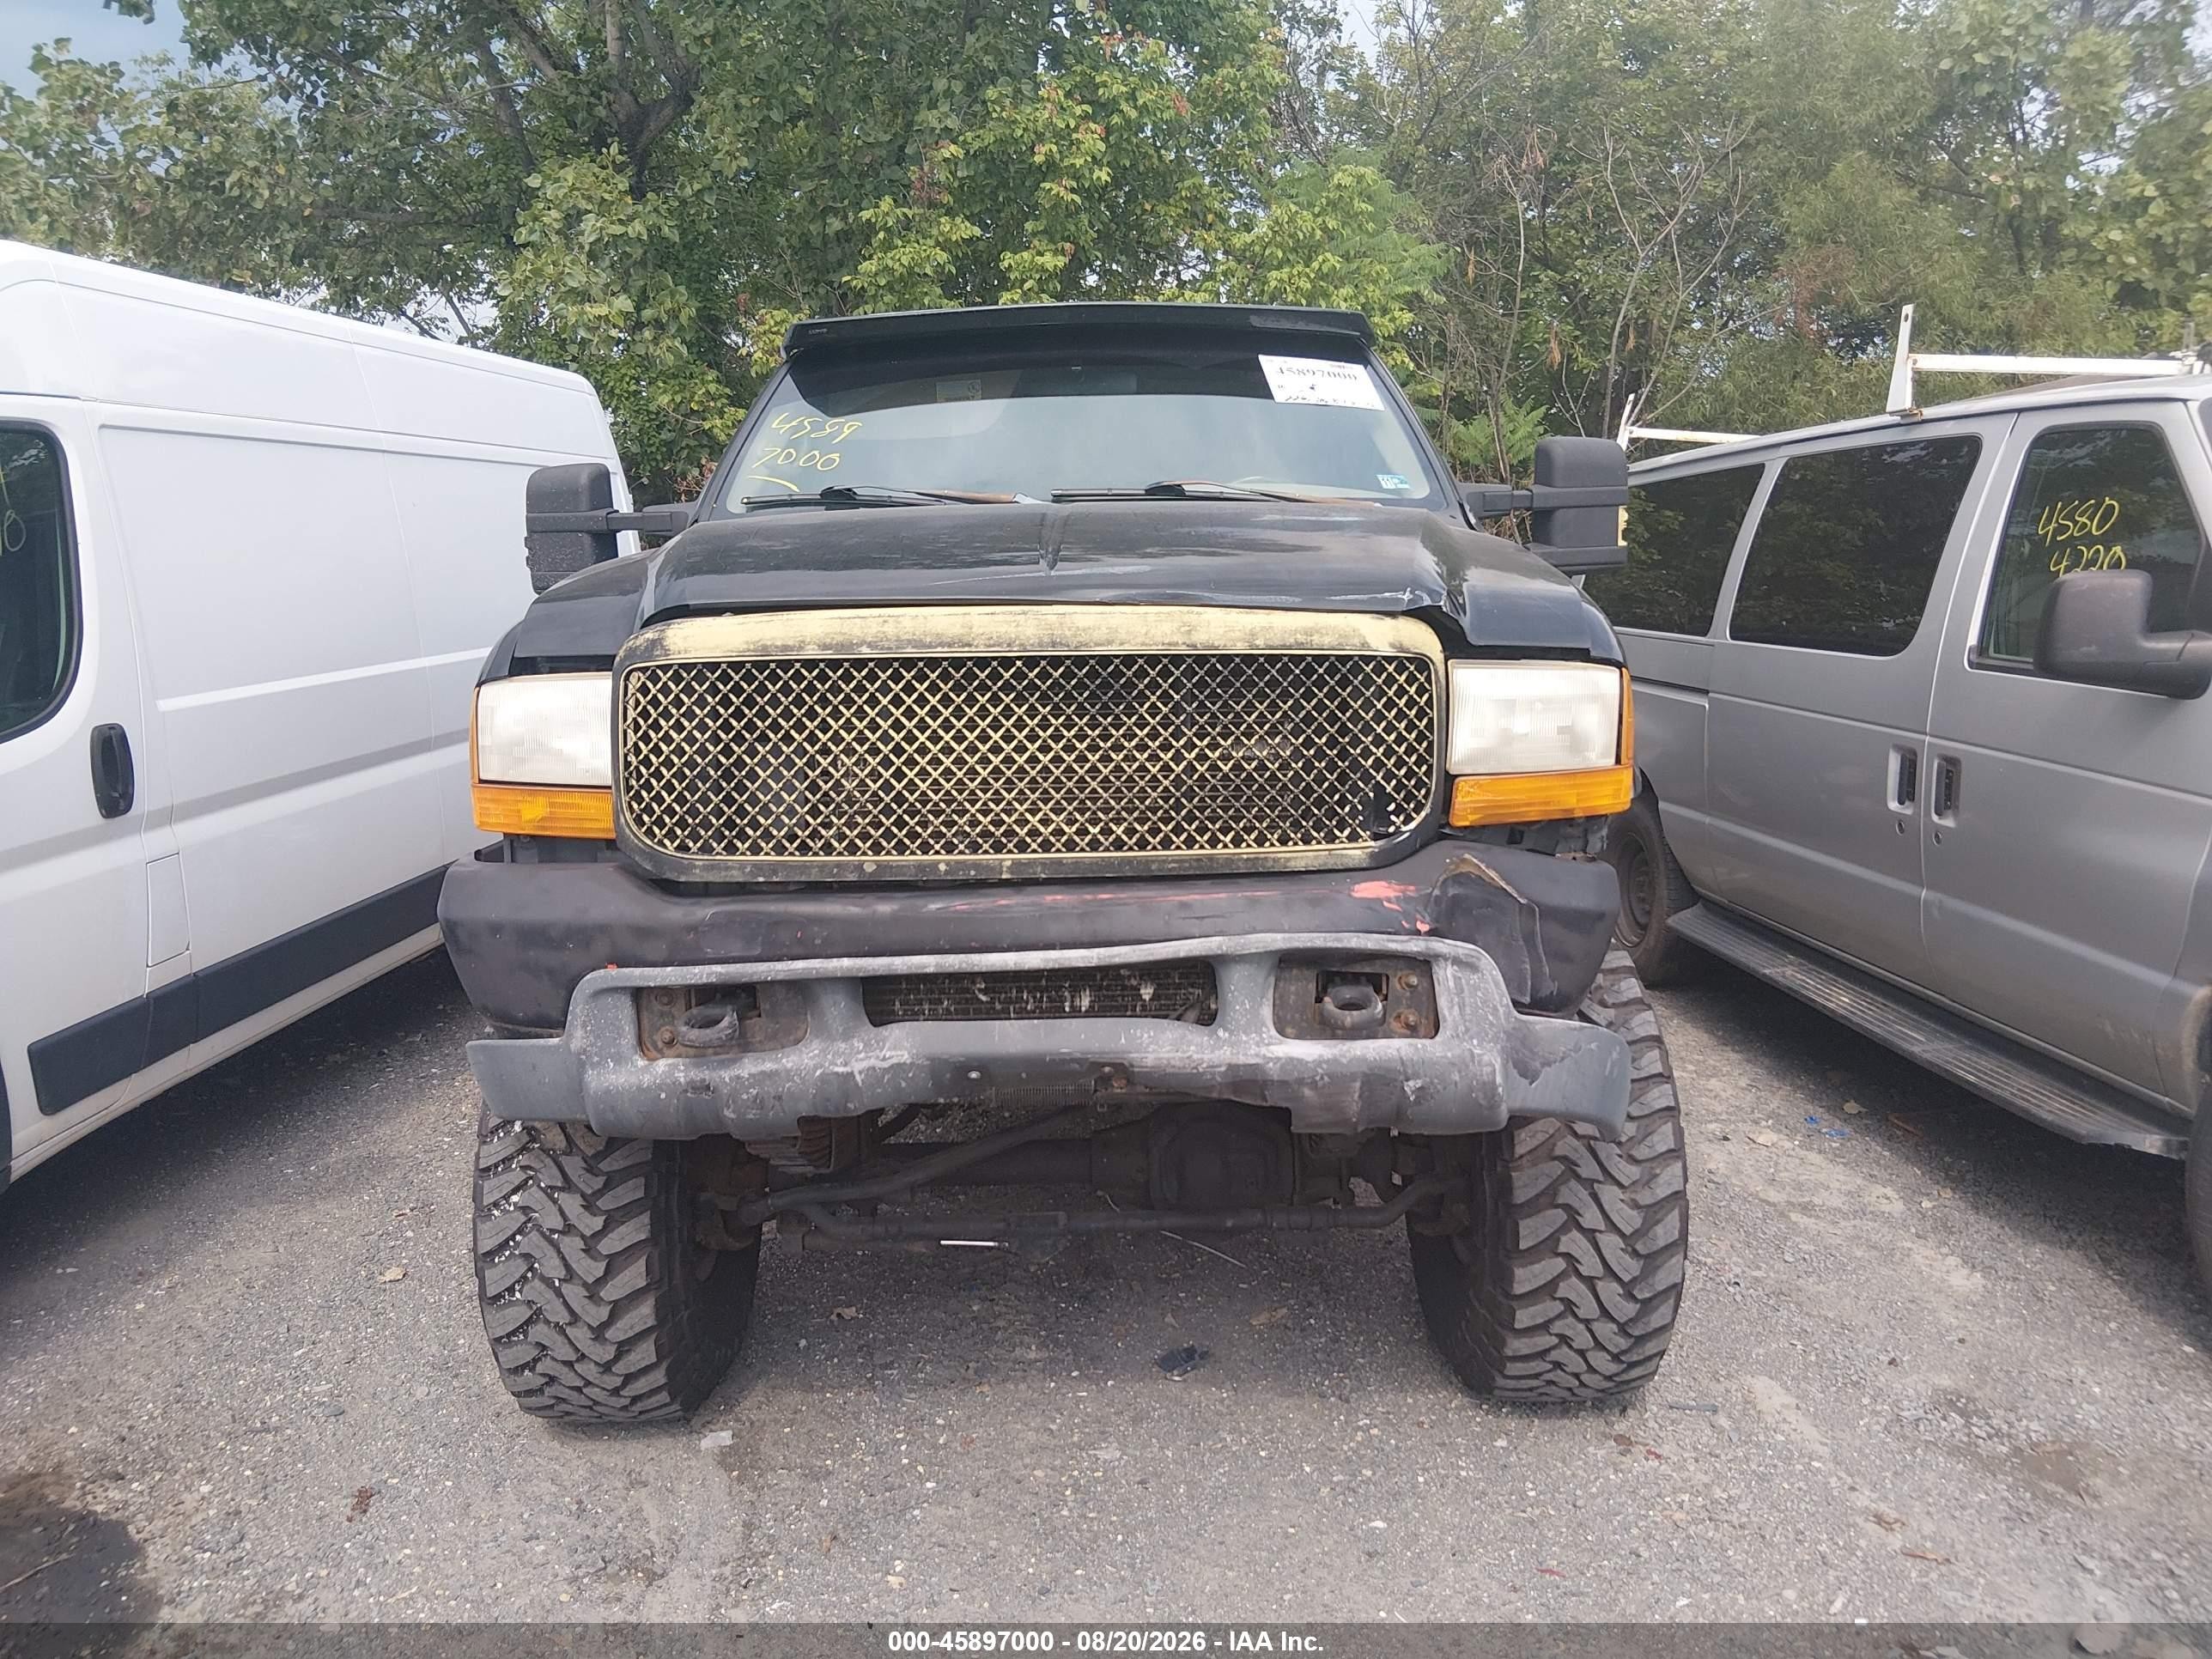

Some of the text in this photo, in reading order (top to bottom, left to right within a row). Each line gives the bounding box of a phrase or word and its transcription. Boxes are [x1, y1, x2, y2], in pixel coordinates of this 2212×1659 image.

[771, 412, 862, 444] 4589
[751, 447, 841, 471] 7000
[2038, 496, 2120, 547] 4580
